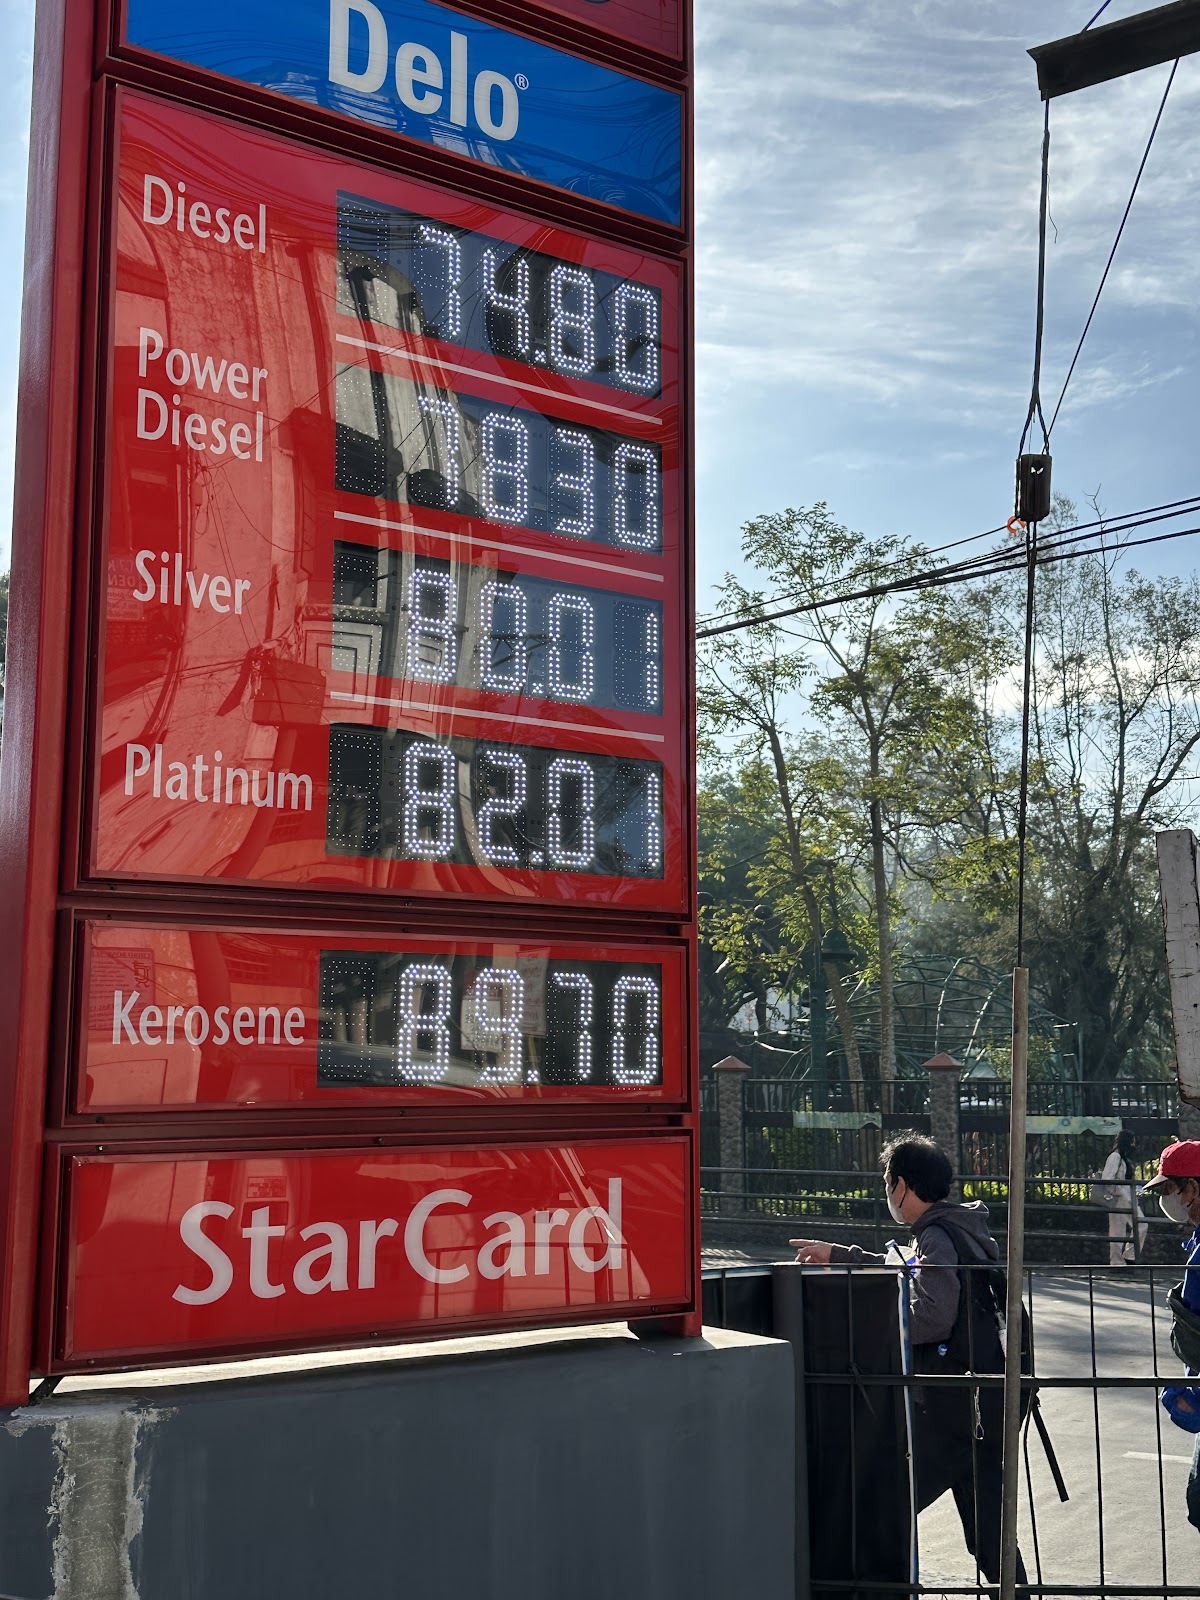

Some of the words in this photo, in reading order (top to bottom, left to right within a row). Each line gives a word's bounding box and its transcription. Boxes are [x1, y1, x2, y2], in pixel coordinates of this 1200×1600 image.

[143, 173, 267, 254] Diesel
[419, 224, 658, 389] 74.80
[137, 327, 268, 402] Power
[136, 390, 265, 463] Diesel
[132, 549, 251, 616] Silver
[406, 568, 659, 706] 80.01
[124, 743, 313, 812] Platinum
[404, 742, 660, 868] 82.01
[112, 990, 306, 1047] Kerosene
[398, 964, 659, 1085] 89.70
[171, 1177, 623, 1306] StarCard
